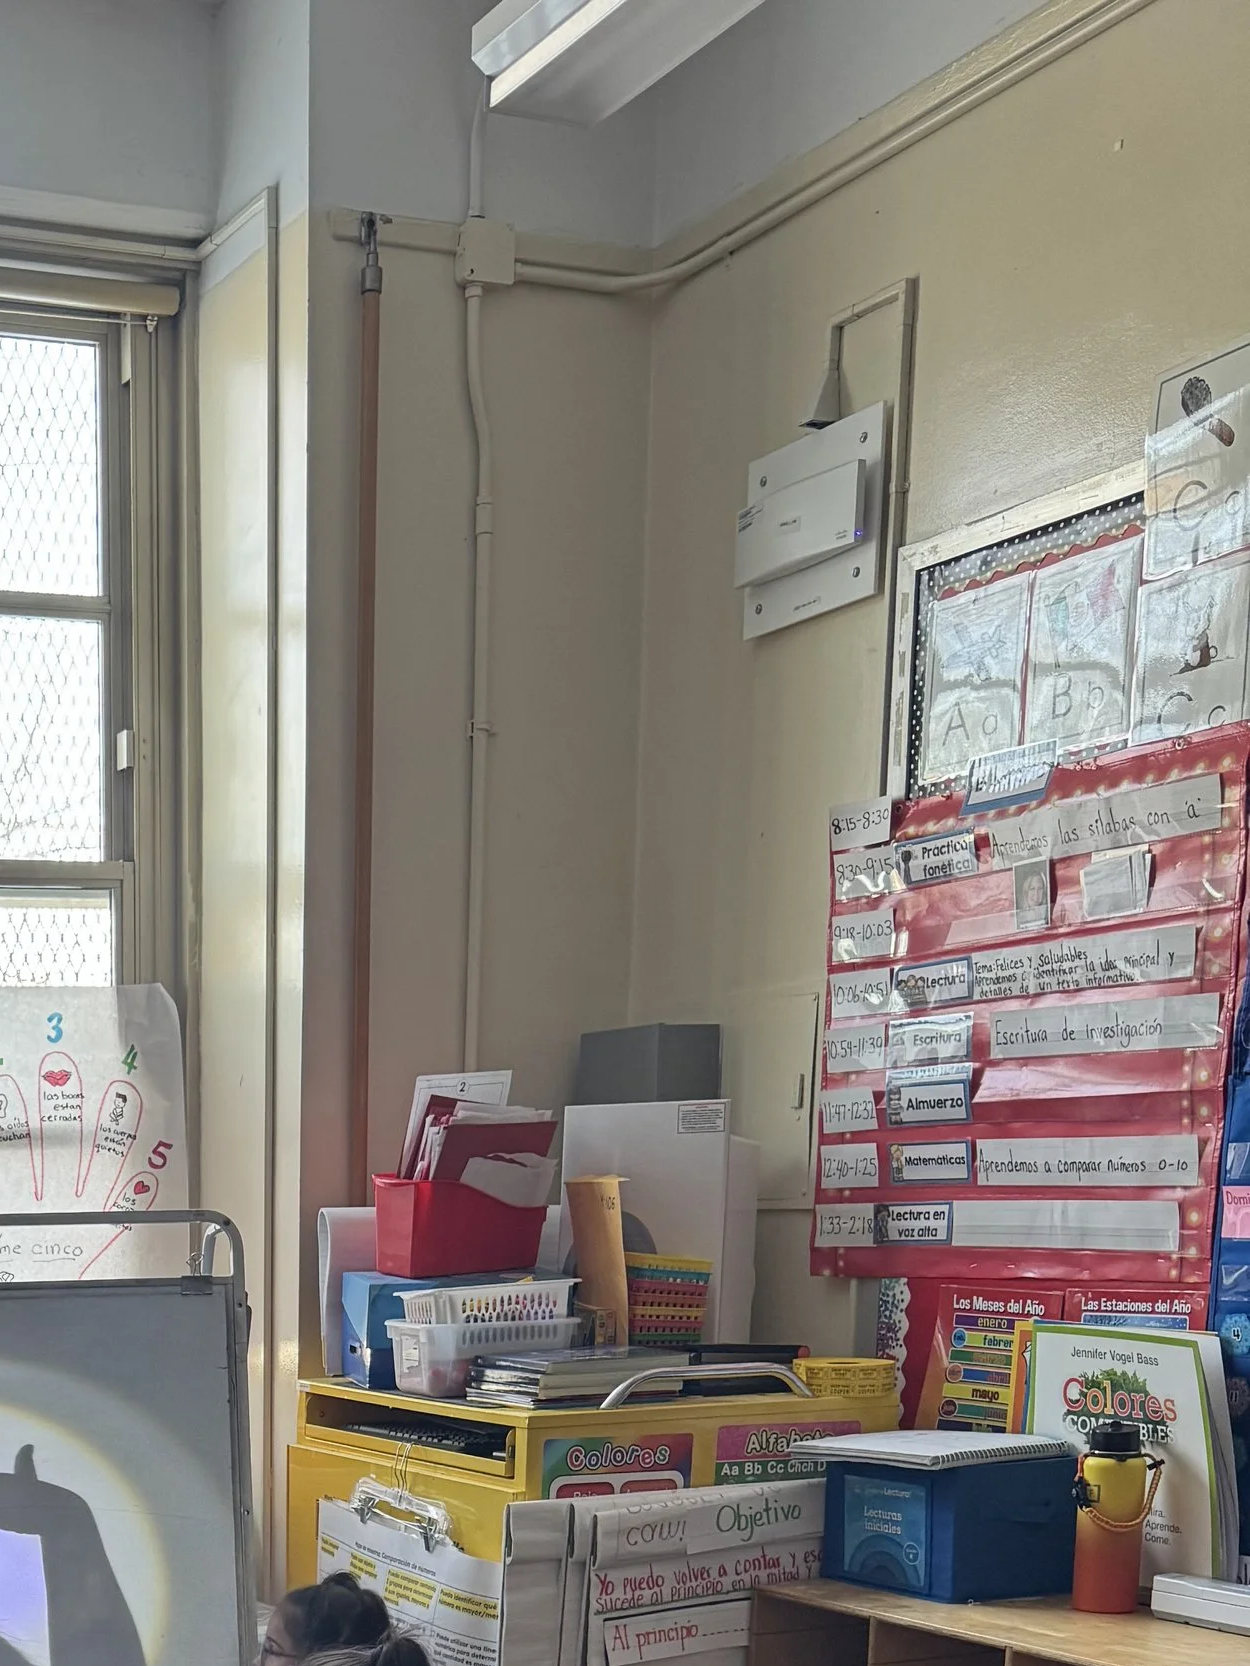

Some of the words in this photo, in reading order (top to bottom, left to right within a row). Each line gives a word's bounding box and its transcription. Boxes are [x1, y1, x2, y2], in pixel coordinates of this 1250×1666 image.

[831, 807, 889, 835] 8:15-8:30
[1058, 819, 1079, 845] las
[1147, 811, 1170, 827] con
[921, 840, 968, 860] Práctica
[923, 858, 971, 878] fonética
[925, 971, 966, 990] Lectura
[46, 1012, 64, 1043] 3
[995, 1019, 1048, 1047] Escritura
[1061, 1021, 1076, 1042] de
[913, 1032, 962, 1047] Escritura
[121, 1043, 138, 1075] 4
[458, 1081, 467, 1093] 2
[906, 1094, 964, 1112] Almuerzo
[148, 1141, 173, 1169] 5
[904, 1151, 966, 1168] Matemáticas
[978, 1147, 1040, 1175] Aprendemos
[1044, 1161, 1052, 1174] a
[1057, 1159, 1102, 1182] comparar
[1107, 1155, 1147, 1173] números
[1158, 1159, 1188, 1171] 0-10
[822, 1153, 877, 1179] 12:40-1:25
[819, 1212, 874, 1237] 1:33-2:18
[890, 1208, 931, 1224] Lectura
[932, 1209, 946, 1222] en
[897, 1227, 914, 1238] voz
[916, 1225, 938, 1238] alta
[31, 1242, 83, 1258] cinco
[953, 1294, 970, 1309] Los
[972, 1296, 1004, 1312] Meses
[1007, 1299, 1022, 1314] del
[1025, 1300, 1045, 1315] Año
[1081, 1297, 1099, 1312] Las
[1101, 1297, 1153, 1314] Estaciones
[1154, 1298, 1170, 1314] del
[1171, 1297, 1191, 1314] Año
[977, 1317, 1007, 1328] enero
[1231, 1328, 1240, 1342] 4
[1070, 1345, 1107, 1360] Jennifer
[1109, 1349, 1134, 1366] Vogel
[1136, 1351, 1159, 1366] Bass
[971, 1387, 999, 1402] mayo
[1062, 1377, 1177, 1423] Colores
[567, 1442, 670, 1471] Colores
[721, 1463, 739, 1476] Aa
[744, 1462, 762, 1475] Bb
[767, 1461, 784, 1474] Cc
[787, 1460, 814, 1473] Chch
[716, 1498, 801, 1542] Objetivo
[863, 1506, 902, 1521] Lecturas
[864, 1520, 902, 1535] iniciales
[1145, 1519, 1182, 1534] Aprende.
[1144, 1531, 1171, 1545] Come.
[612, 1624, 630, 1651] Al
[636, 1620, 698, 1660] principio
